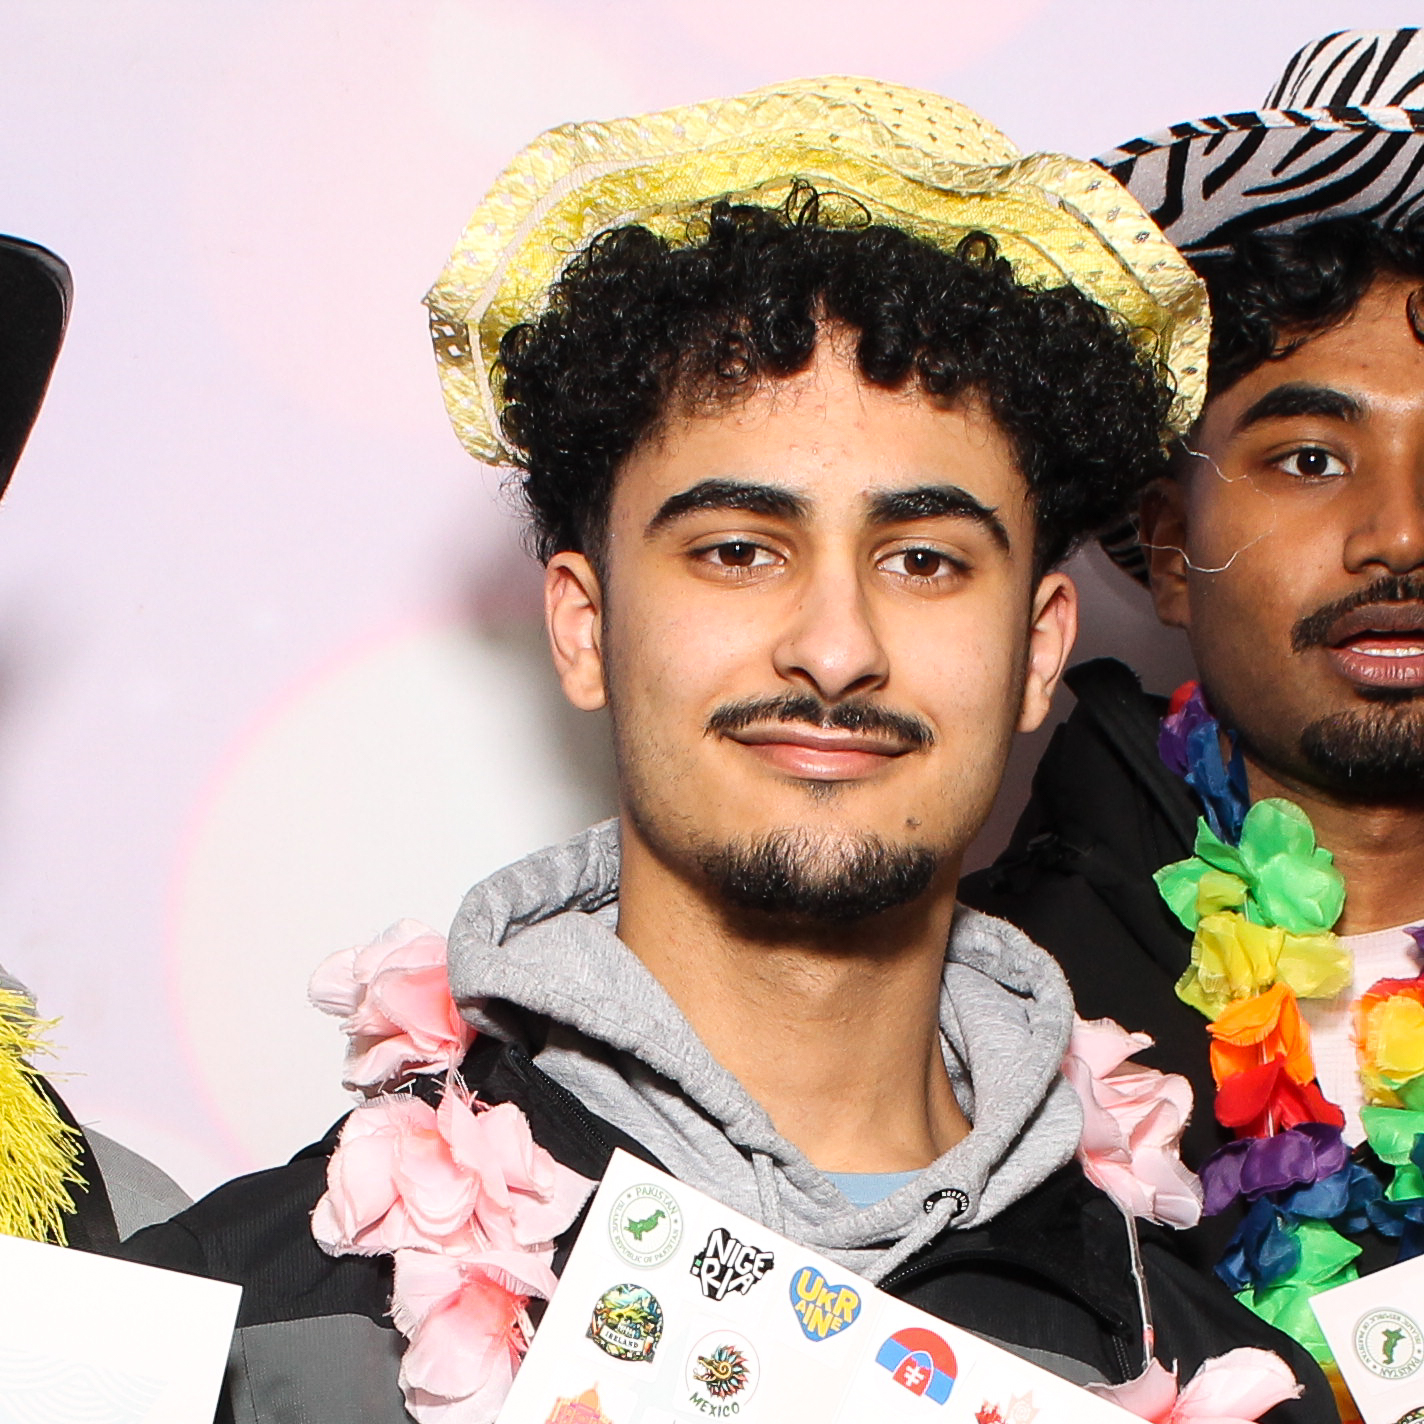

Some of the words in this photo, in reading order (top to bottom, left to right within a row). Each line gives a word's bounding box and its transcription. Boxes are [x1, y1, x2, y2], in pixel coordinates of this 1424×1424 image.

[636, 1187, 678, 1214] PAKISTAN
[604, 1331, 639, 1349] IRELAND
[1380, 1357, 1422, 1377] PAKISTAN
[689, 1391, 740, 1418] MEXICO
